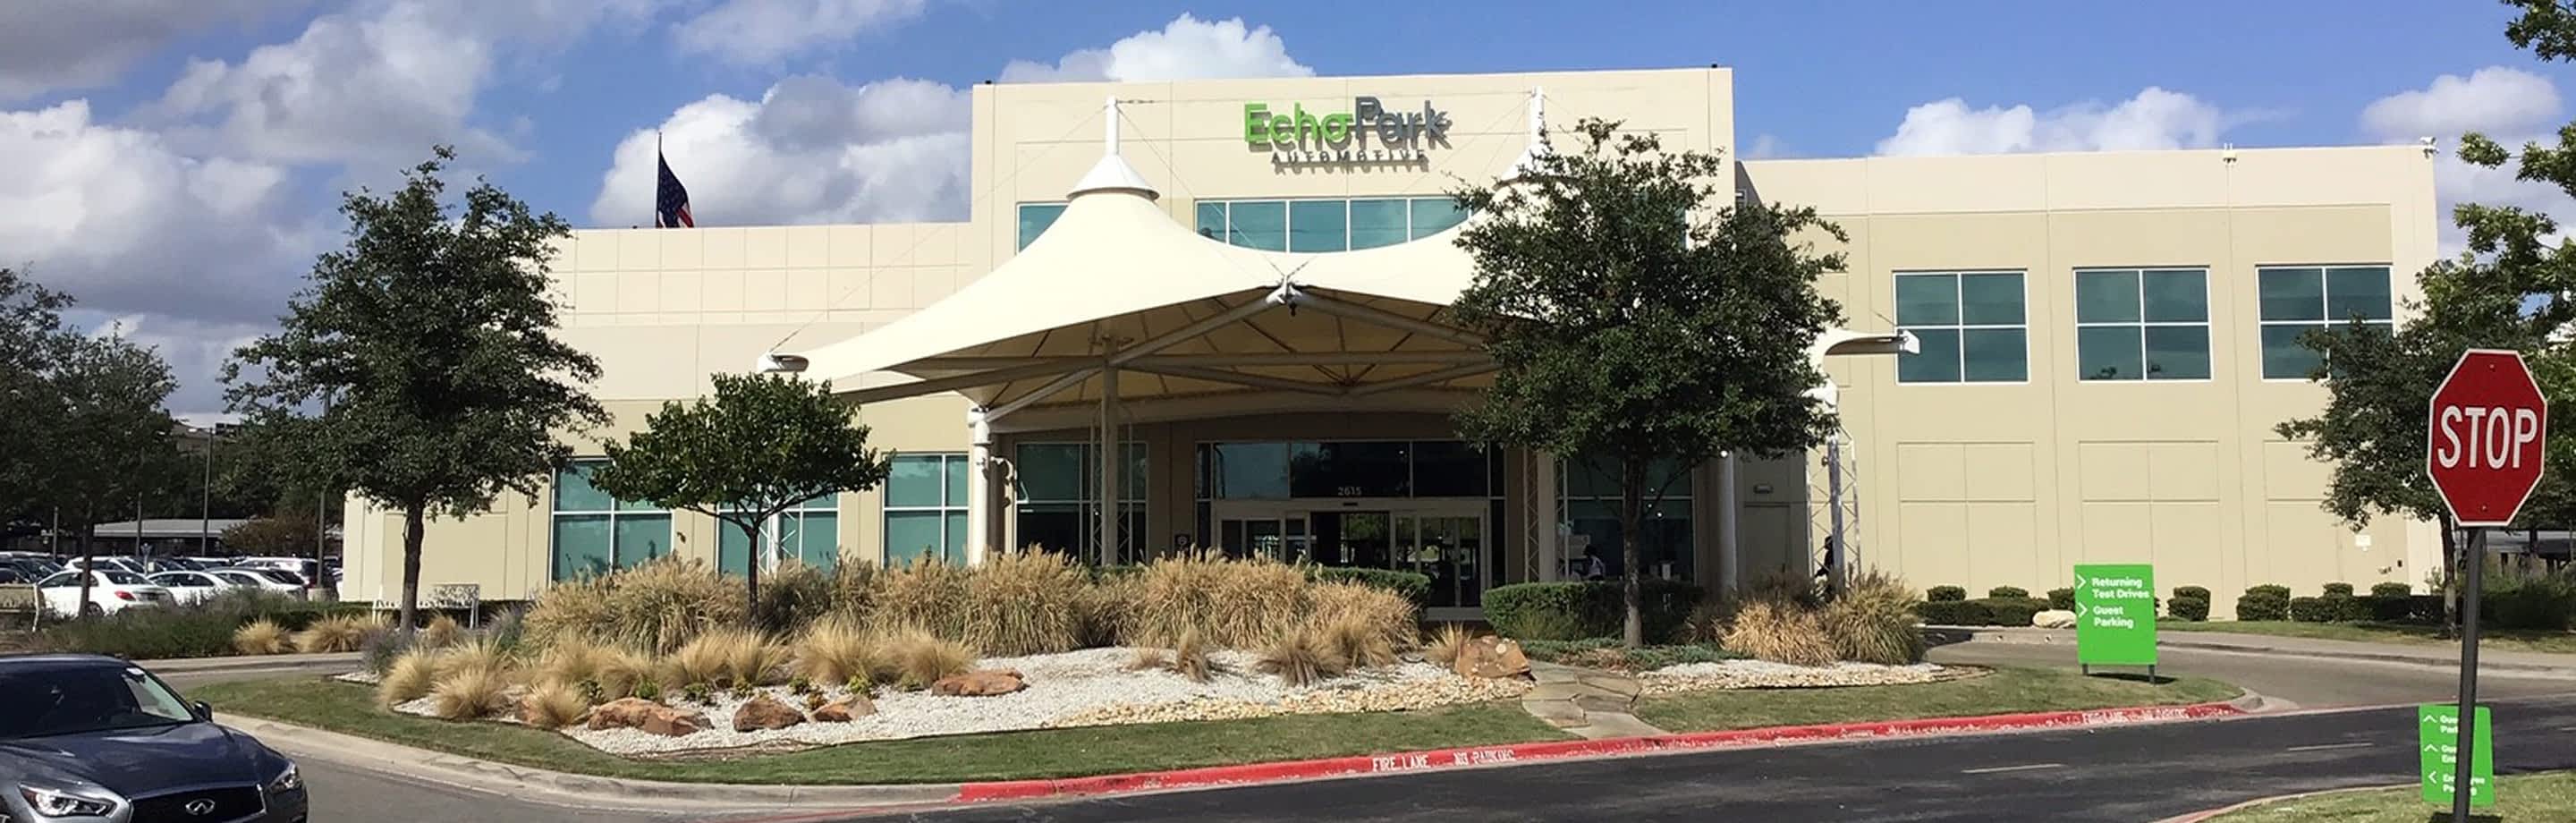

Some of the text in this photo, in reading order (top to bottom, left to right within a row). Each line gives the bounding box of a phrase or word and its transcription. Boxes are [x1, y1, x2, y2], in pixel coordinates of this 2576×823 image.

[1272, 149, 1428, 165] AUTOMOTIVE
[2437, 405, 2538, 469] STOP
[1337, 486, 1362, 496] 2615
[2092, 576, 2142, 589] Returning
[2092, 589, 2149, 598] Test Drives
[2093, 606, 2123, 615] Guest
[2094, 616, 2133, 629] Parking
[1372, 757, 1398, 772] FIRE
[1402, 754, 1430, 770] LANE
